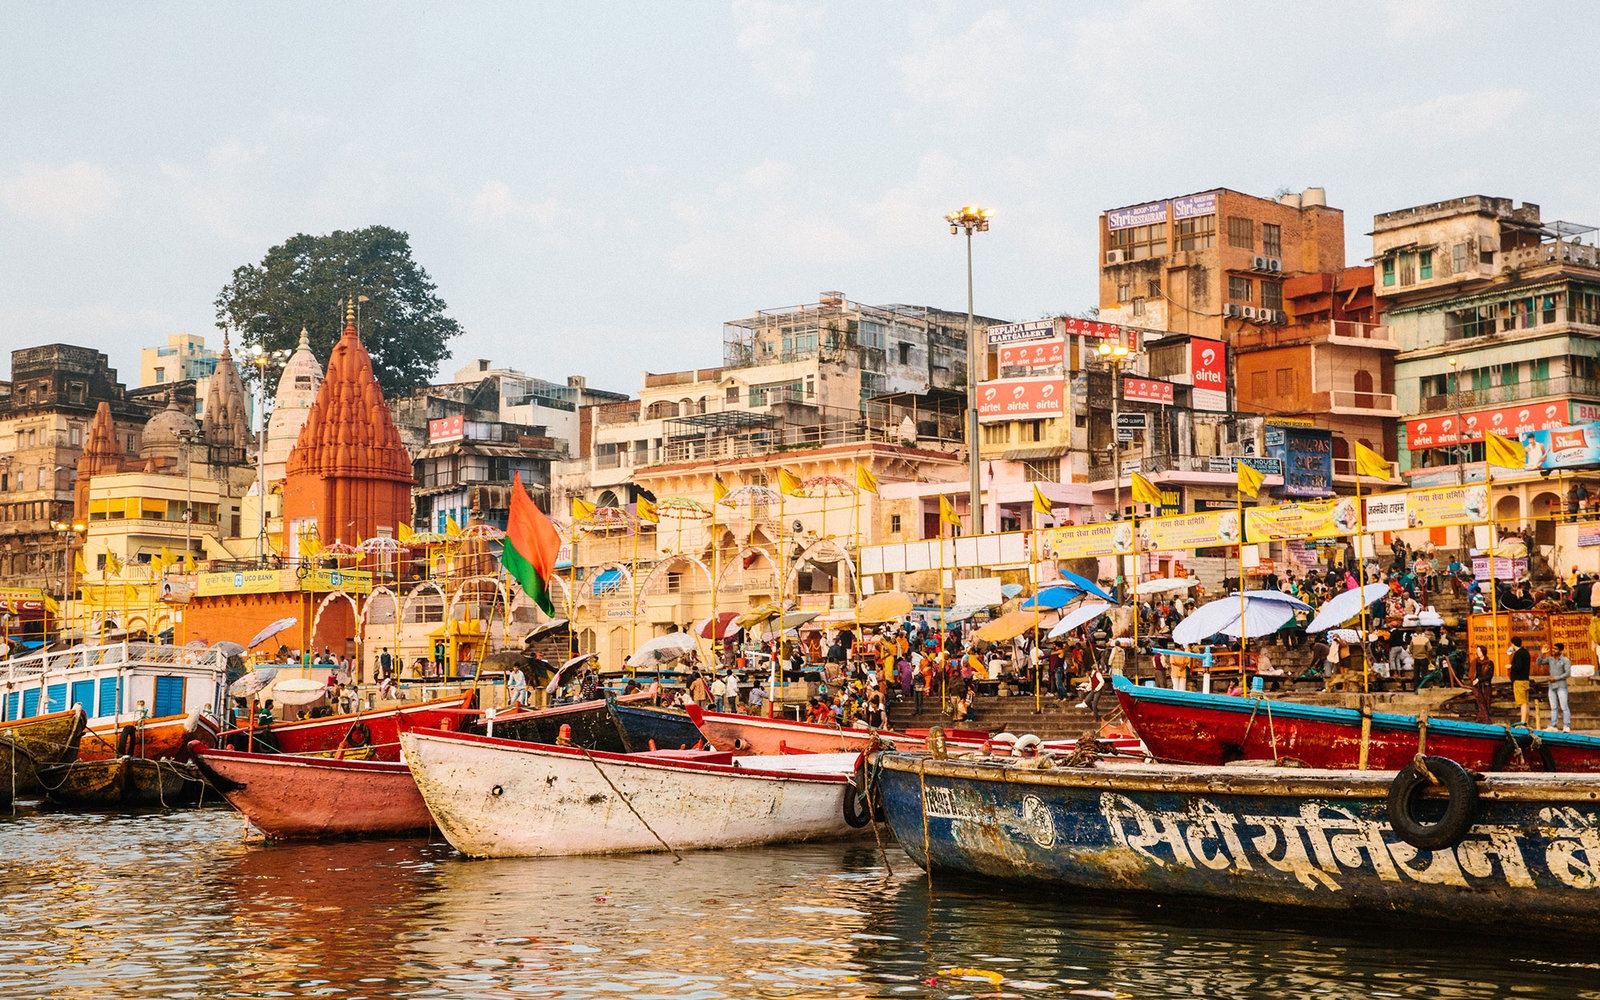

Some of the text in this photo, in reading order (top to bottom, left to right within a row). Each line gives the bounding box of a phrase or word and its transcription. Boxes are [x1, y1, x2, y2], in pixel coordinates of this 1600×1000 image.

[1176, 198, 1192, 216] Shri
[1110, 210, 1131, 227] Shri
[1130, 211, 1167, 224] RESTAURANT
[990, 324, 1024, 336] REPLICA
[1196, 368, 1222, 386] airtel
[980, 400, 1058, 412] airtel airtel airtel
[1414, 437, 1432, 446] airtel
[1438, 434, 1457, 444] airtel
[1463, 431, 1482, 440] atel
[1514, 423, 1535, 434] airtel
[1542, 419, 1563, 430] airtel
[1161, 491, 1180, 505] ANDEY
[1100, 791, 1254, 871] सिटी
[1244, 798, 1538, 892] यूनियन
